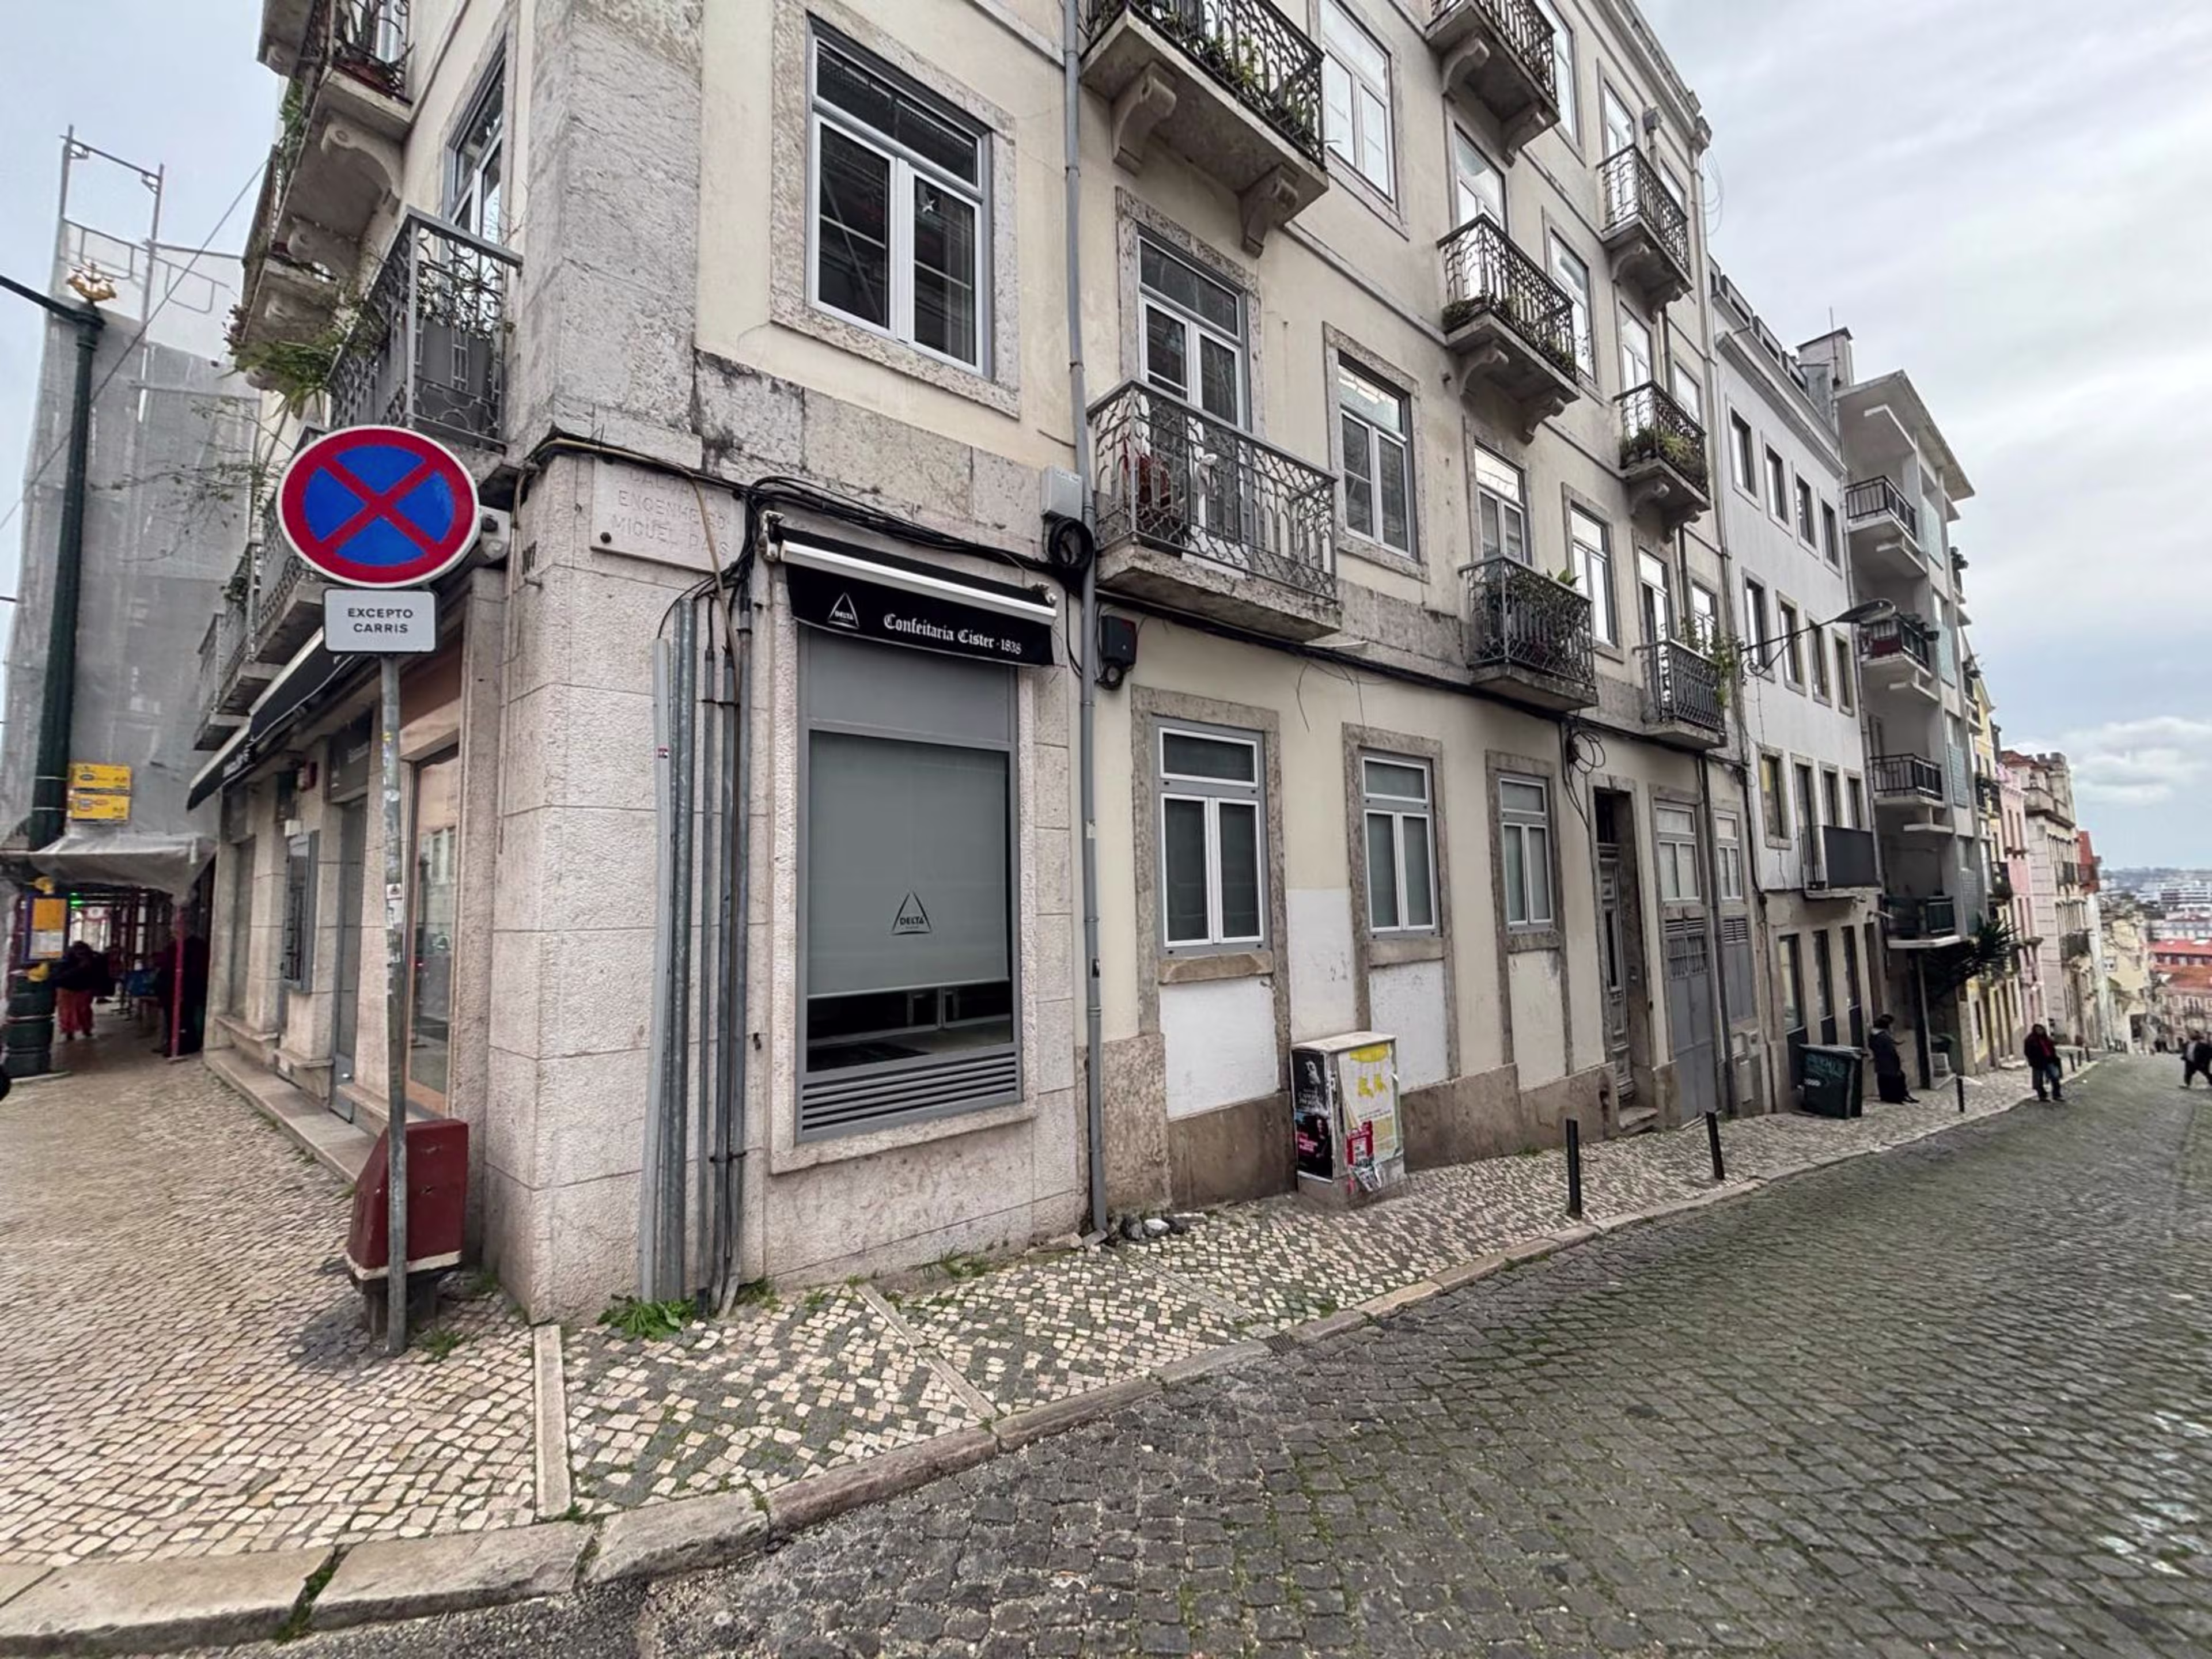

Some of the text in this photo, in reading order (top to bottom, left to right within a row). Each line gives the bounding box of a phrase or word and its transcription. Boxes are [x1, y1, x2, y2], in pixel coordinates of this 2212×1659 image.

[619, 490, 729, 531] ENGENHERO
[612, 515, 729, 556] MIGUEL PAS
[347, 608, 414, 619] EXCEPTO
[835, 610, 854, 620] DELTA
[353, 623, 408, 633] CARRIS
[884, 613, 954, 641] Confeitaria
[957, 629, 995, 649] Cister
[900, 916, 924, 925] DELTA
